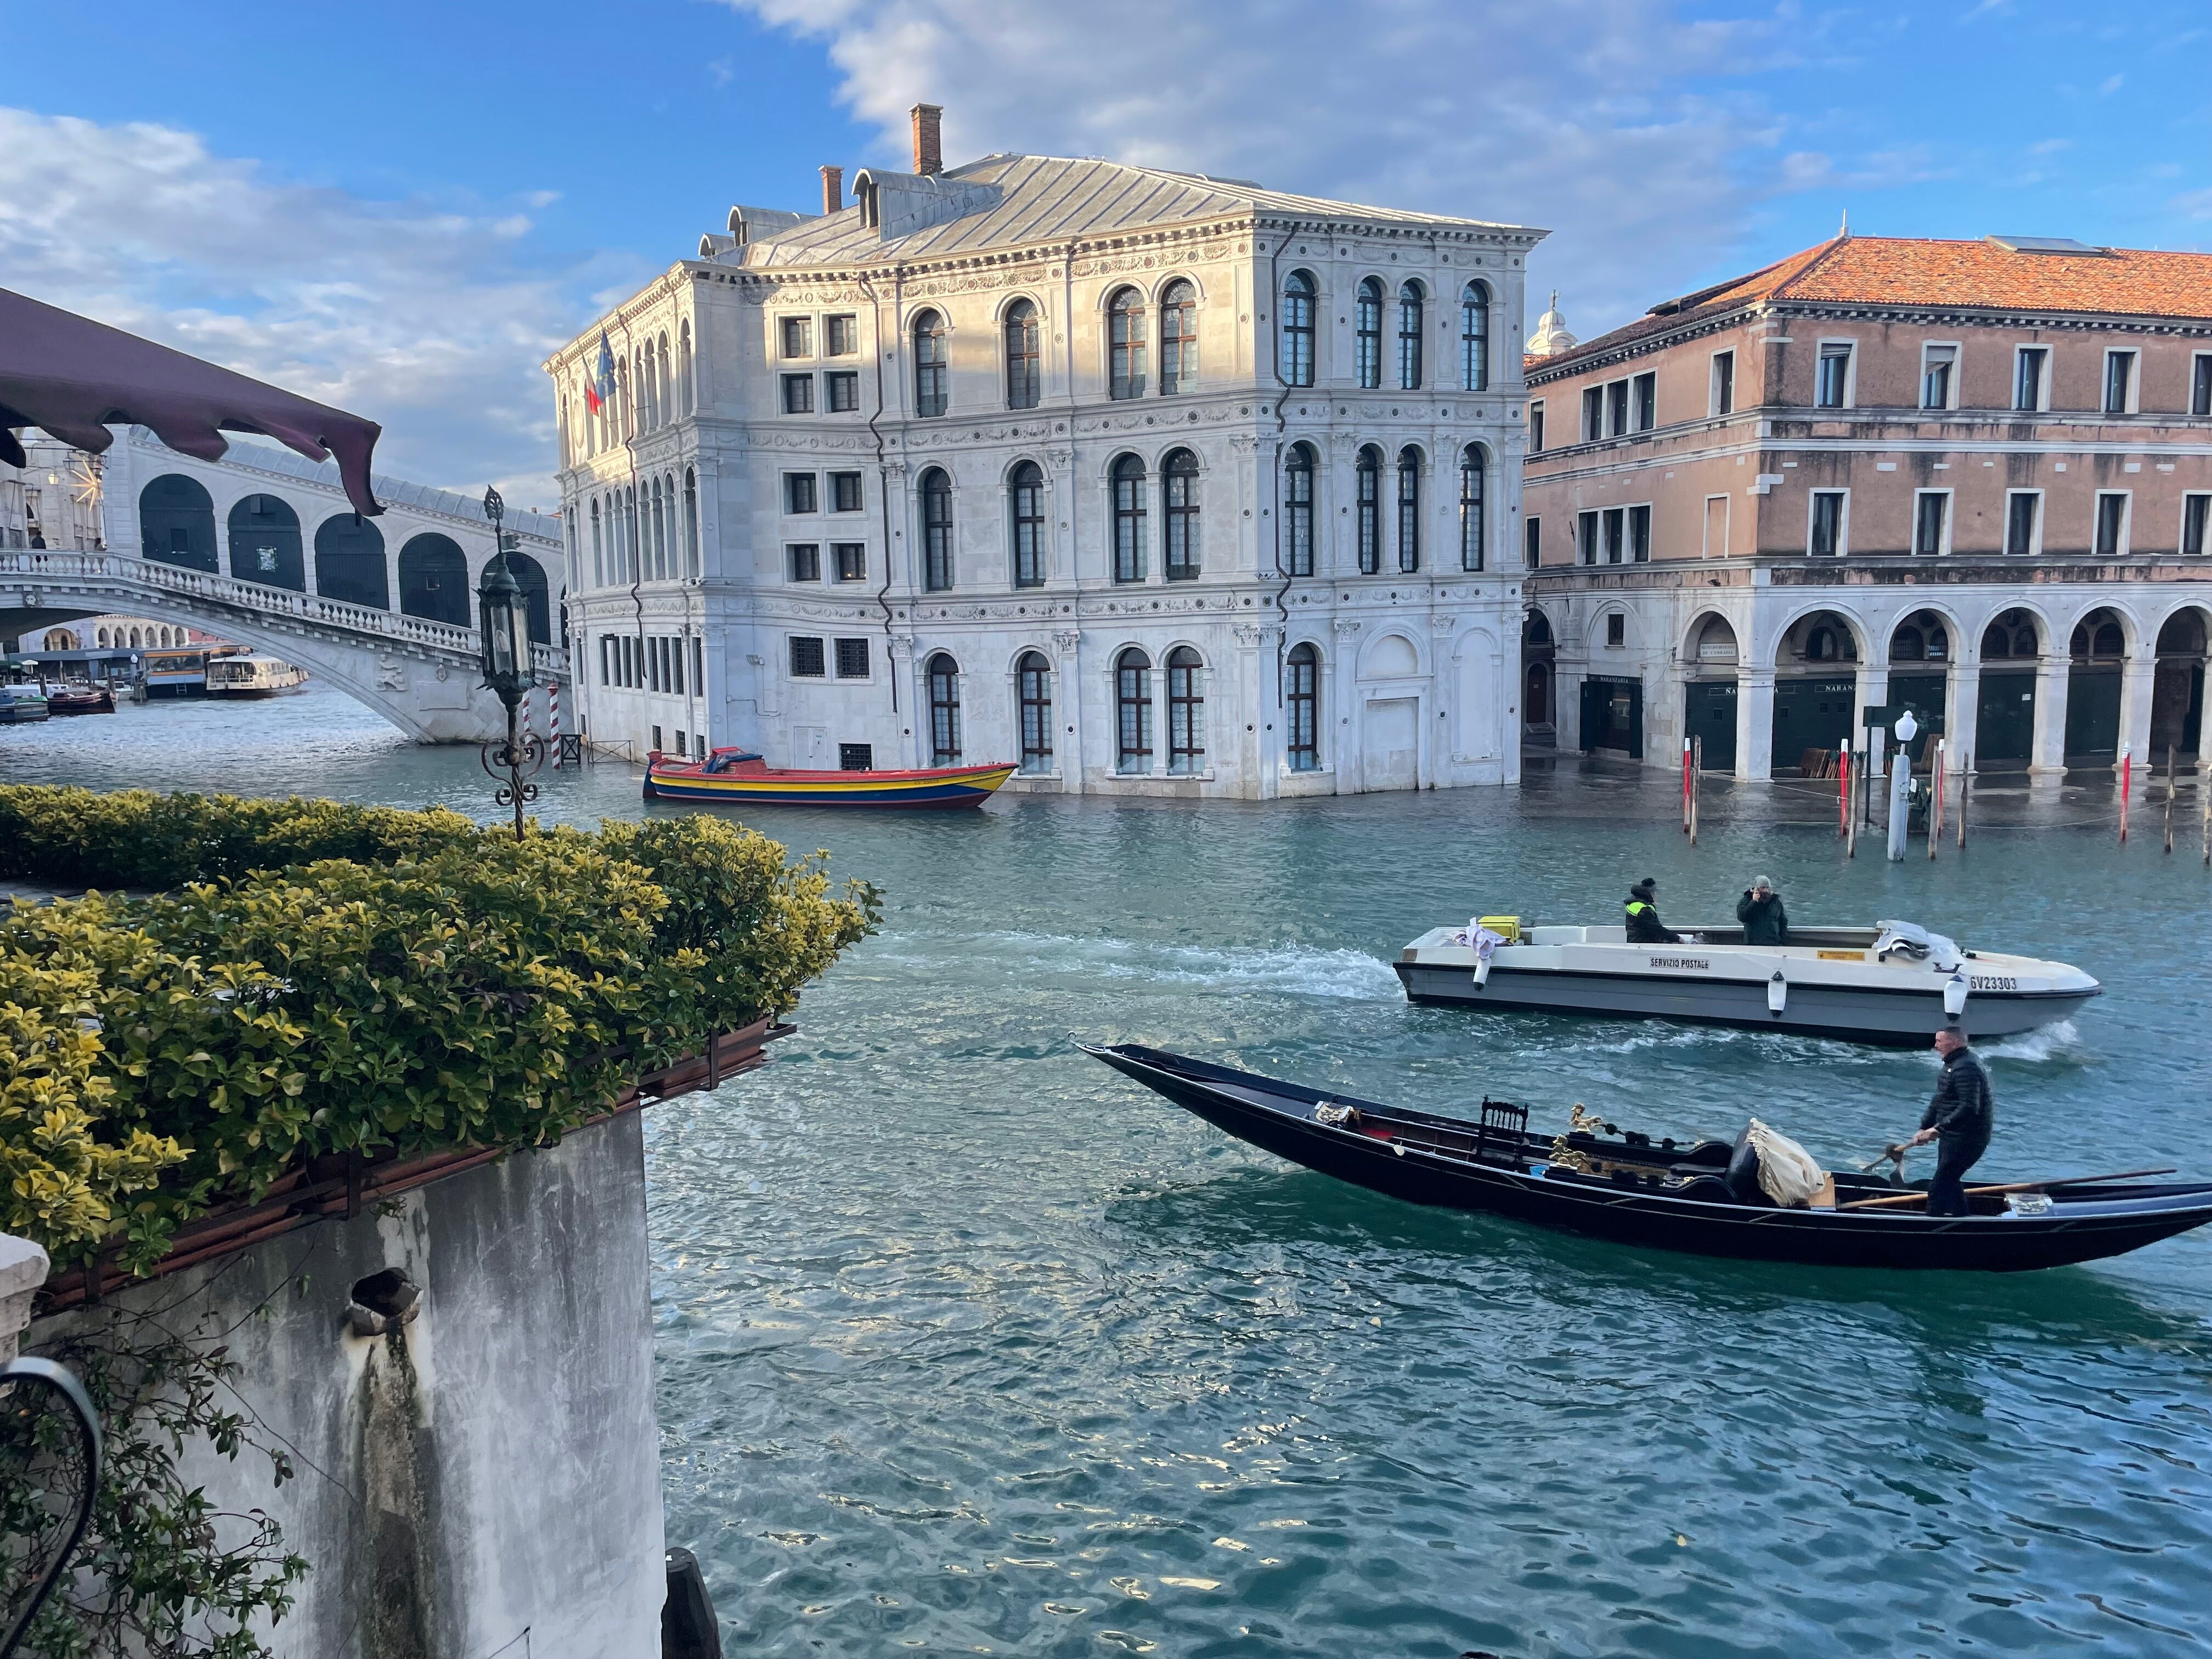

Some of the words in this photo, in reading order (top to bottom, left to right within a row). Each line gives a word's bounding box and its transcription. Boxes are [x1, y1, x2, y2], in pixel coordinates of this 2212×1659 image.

[1650, 958, 1679, 967] SERVIZIO
[1681, 960, 1708, 969] POSTALE
[1970, 977, 2017, 990] 6V23303
